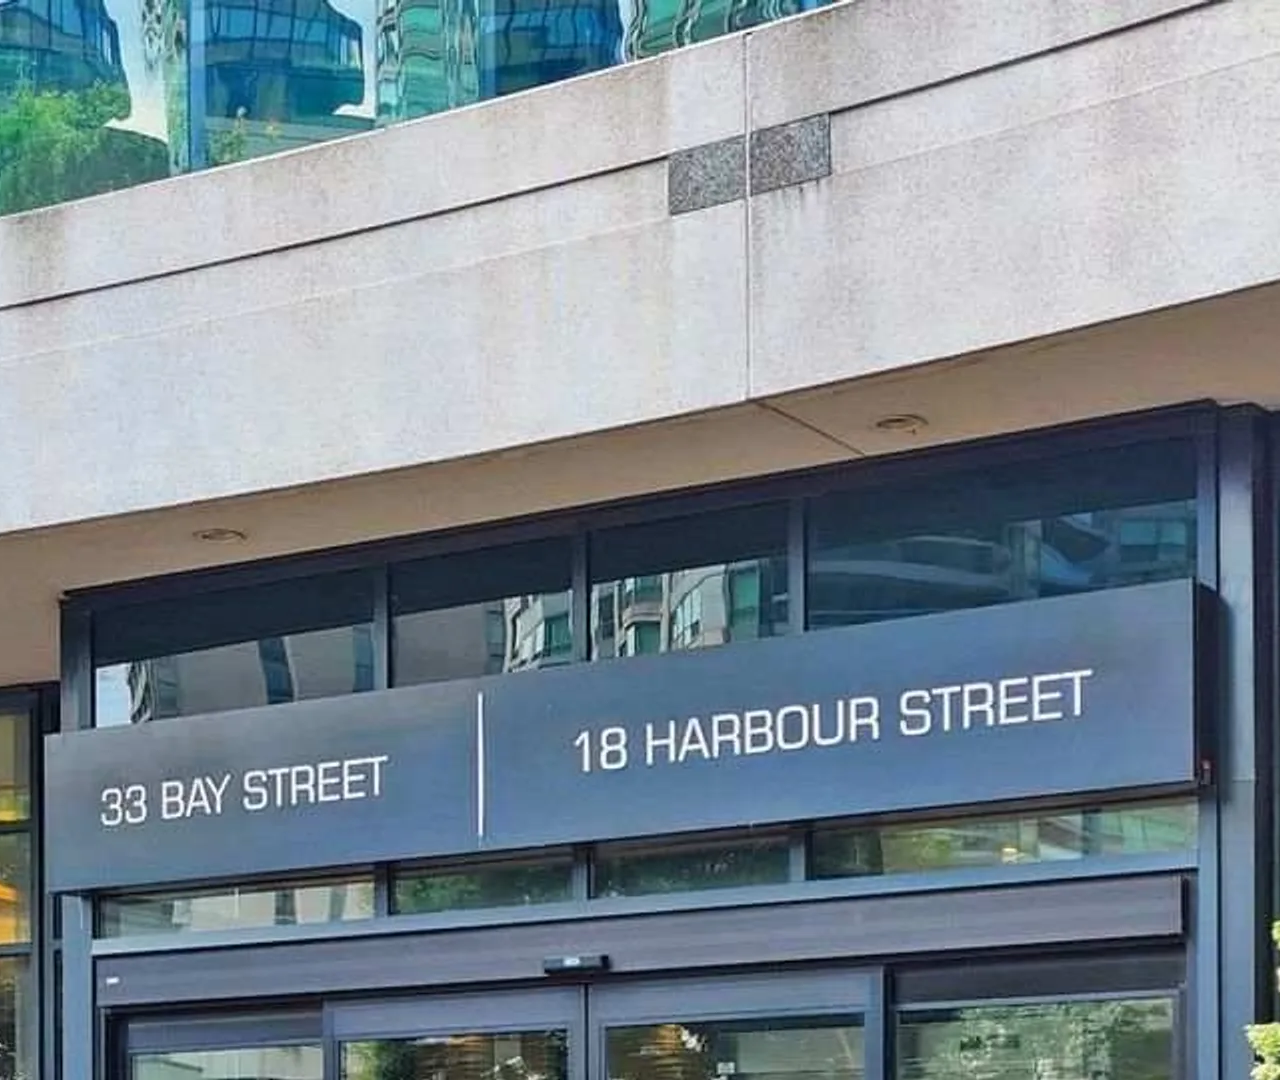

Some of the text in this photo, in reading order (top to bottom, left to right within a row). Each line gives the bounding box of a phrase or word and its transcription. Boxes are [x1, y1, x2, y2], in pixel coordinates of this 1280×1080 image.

[574, 668, 1094, 773] 18 HARBOUR STREET
[101, 755, 389, 826] 33 BAY STREET
